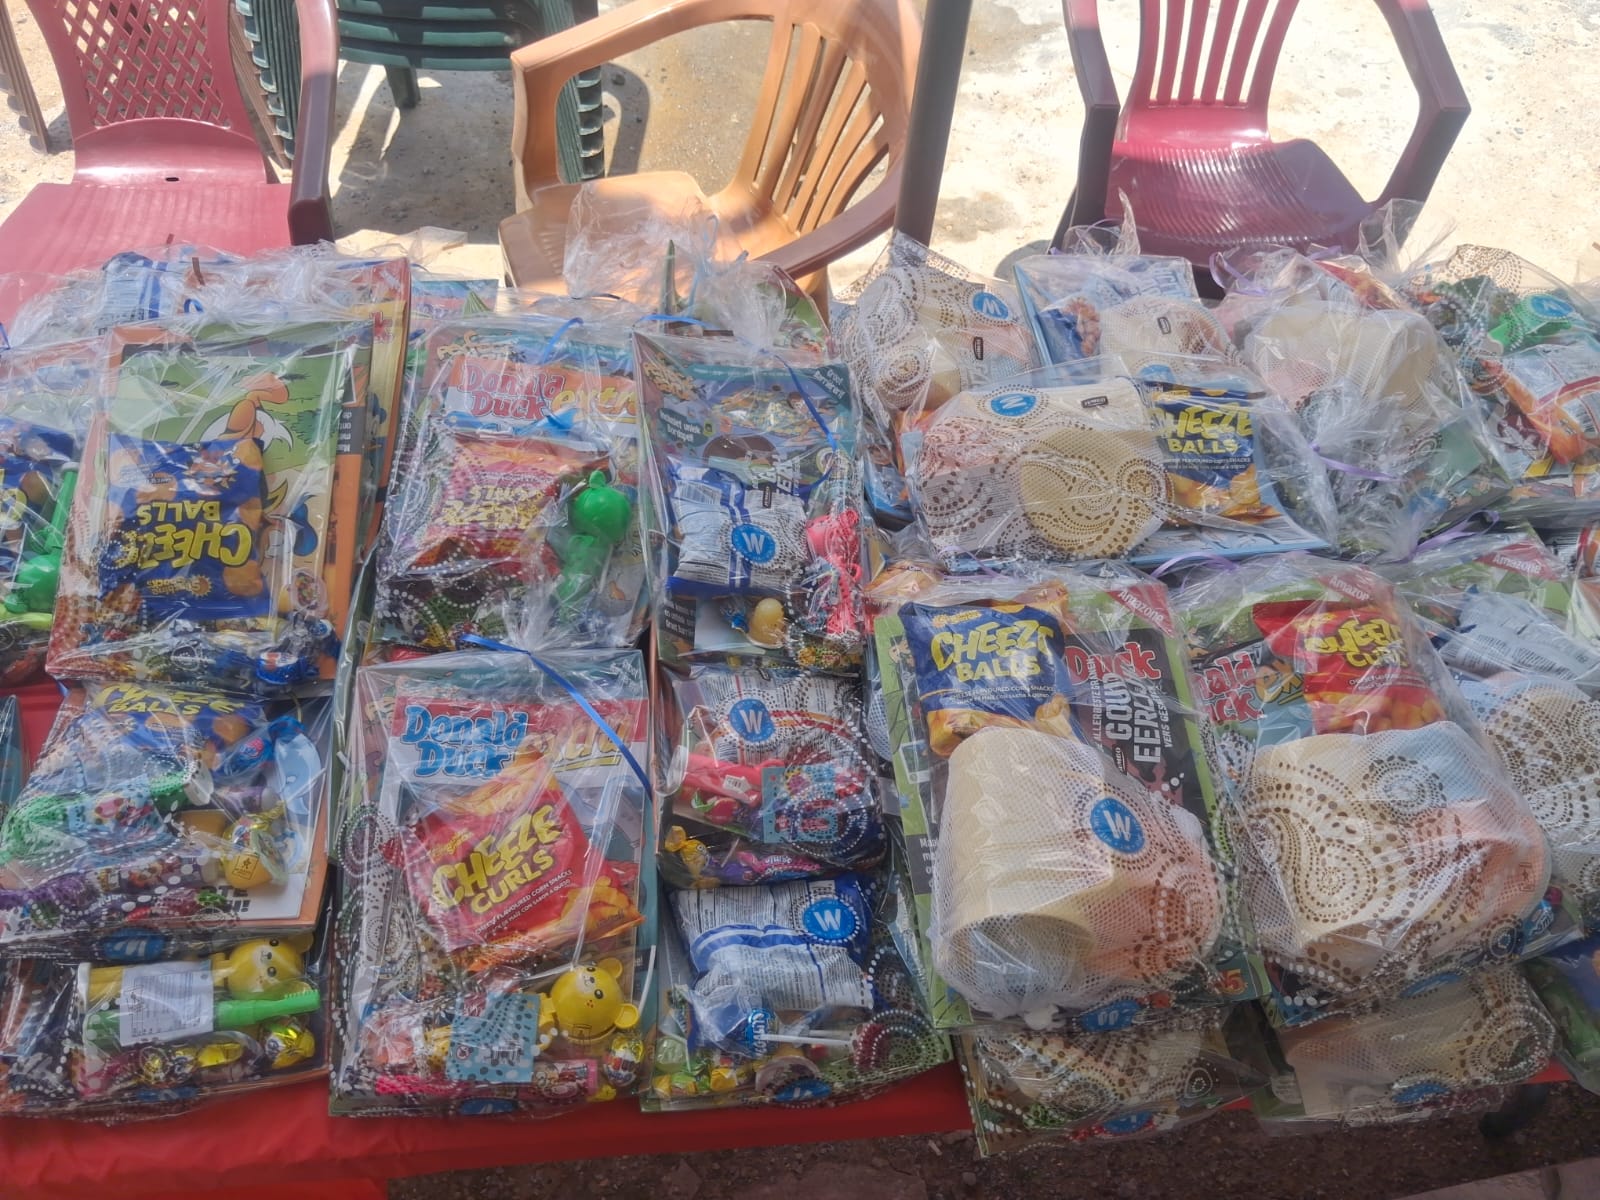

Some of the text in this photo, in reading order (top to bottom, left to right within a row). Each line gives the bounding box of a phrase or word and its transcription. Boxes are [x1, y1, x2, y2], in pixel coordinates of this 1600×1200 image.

[1167, 437, 1239, 455] BALLS
[136, 500, 221, 525] BALLS
[741, 531, 766, 556] W
[1118, 590, 1164, 622] Amazone
[955, 654, 1042, 683] BALLS
[1064, 641, 1162, 687] Duck
[107, 701, 202, 716] BALLS
[739, 708, 763, 735] W
[1102, 671, 1134, 741] GOUD
[401, 704, 529, 749] Donald
[1160, 724, 1174, 749] VERS
[414, 740, 516, 779] Duck
[1104, 807, 1132, 842] W
[431, 804, 563, 910] CHEEZE
[469, 848, 555, 915] CURLS
[496, 894, 532, 921] FLAVOURED
[531, 883, 549, 898] CORN
[548, 869, 573, 888] SNACKS
[813, 908, 842, 932] W
